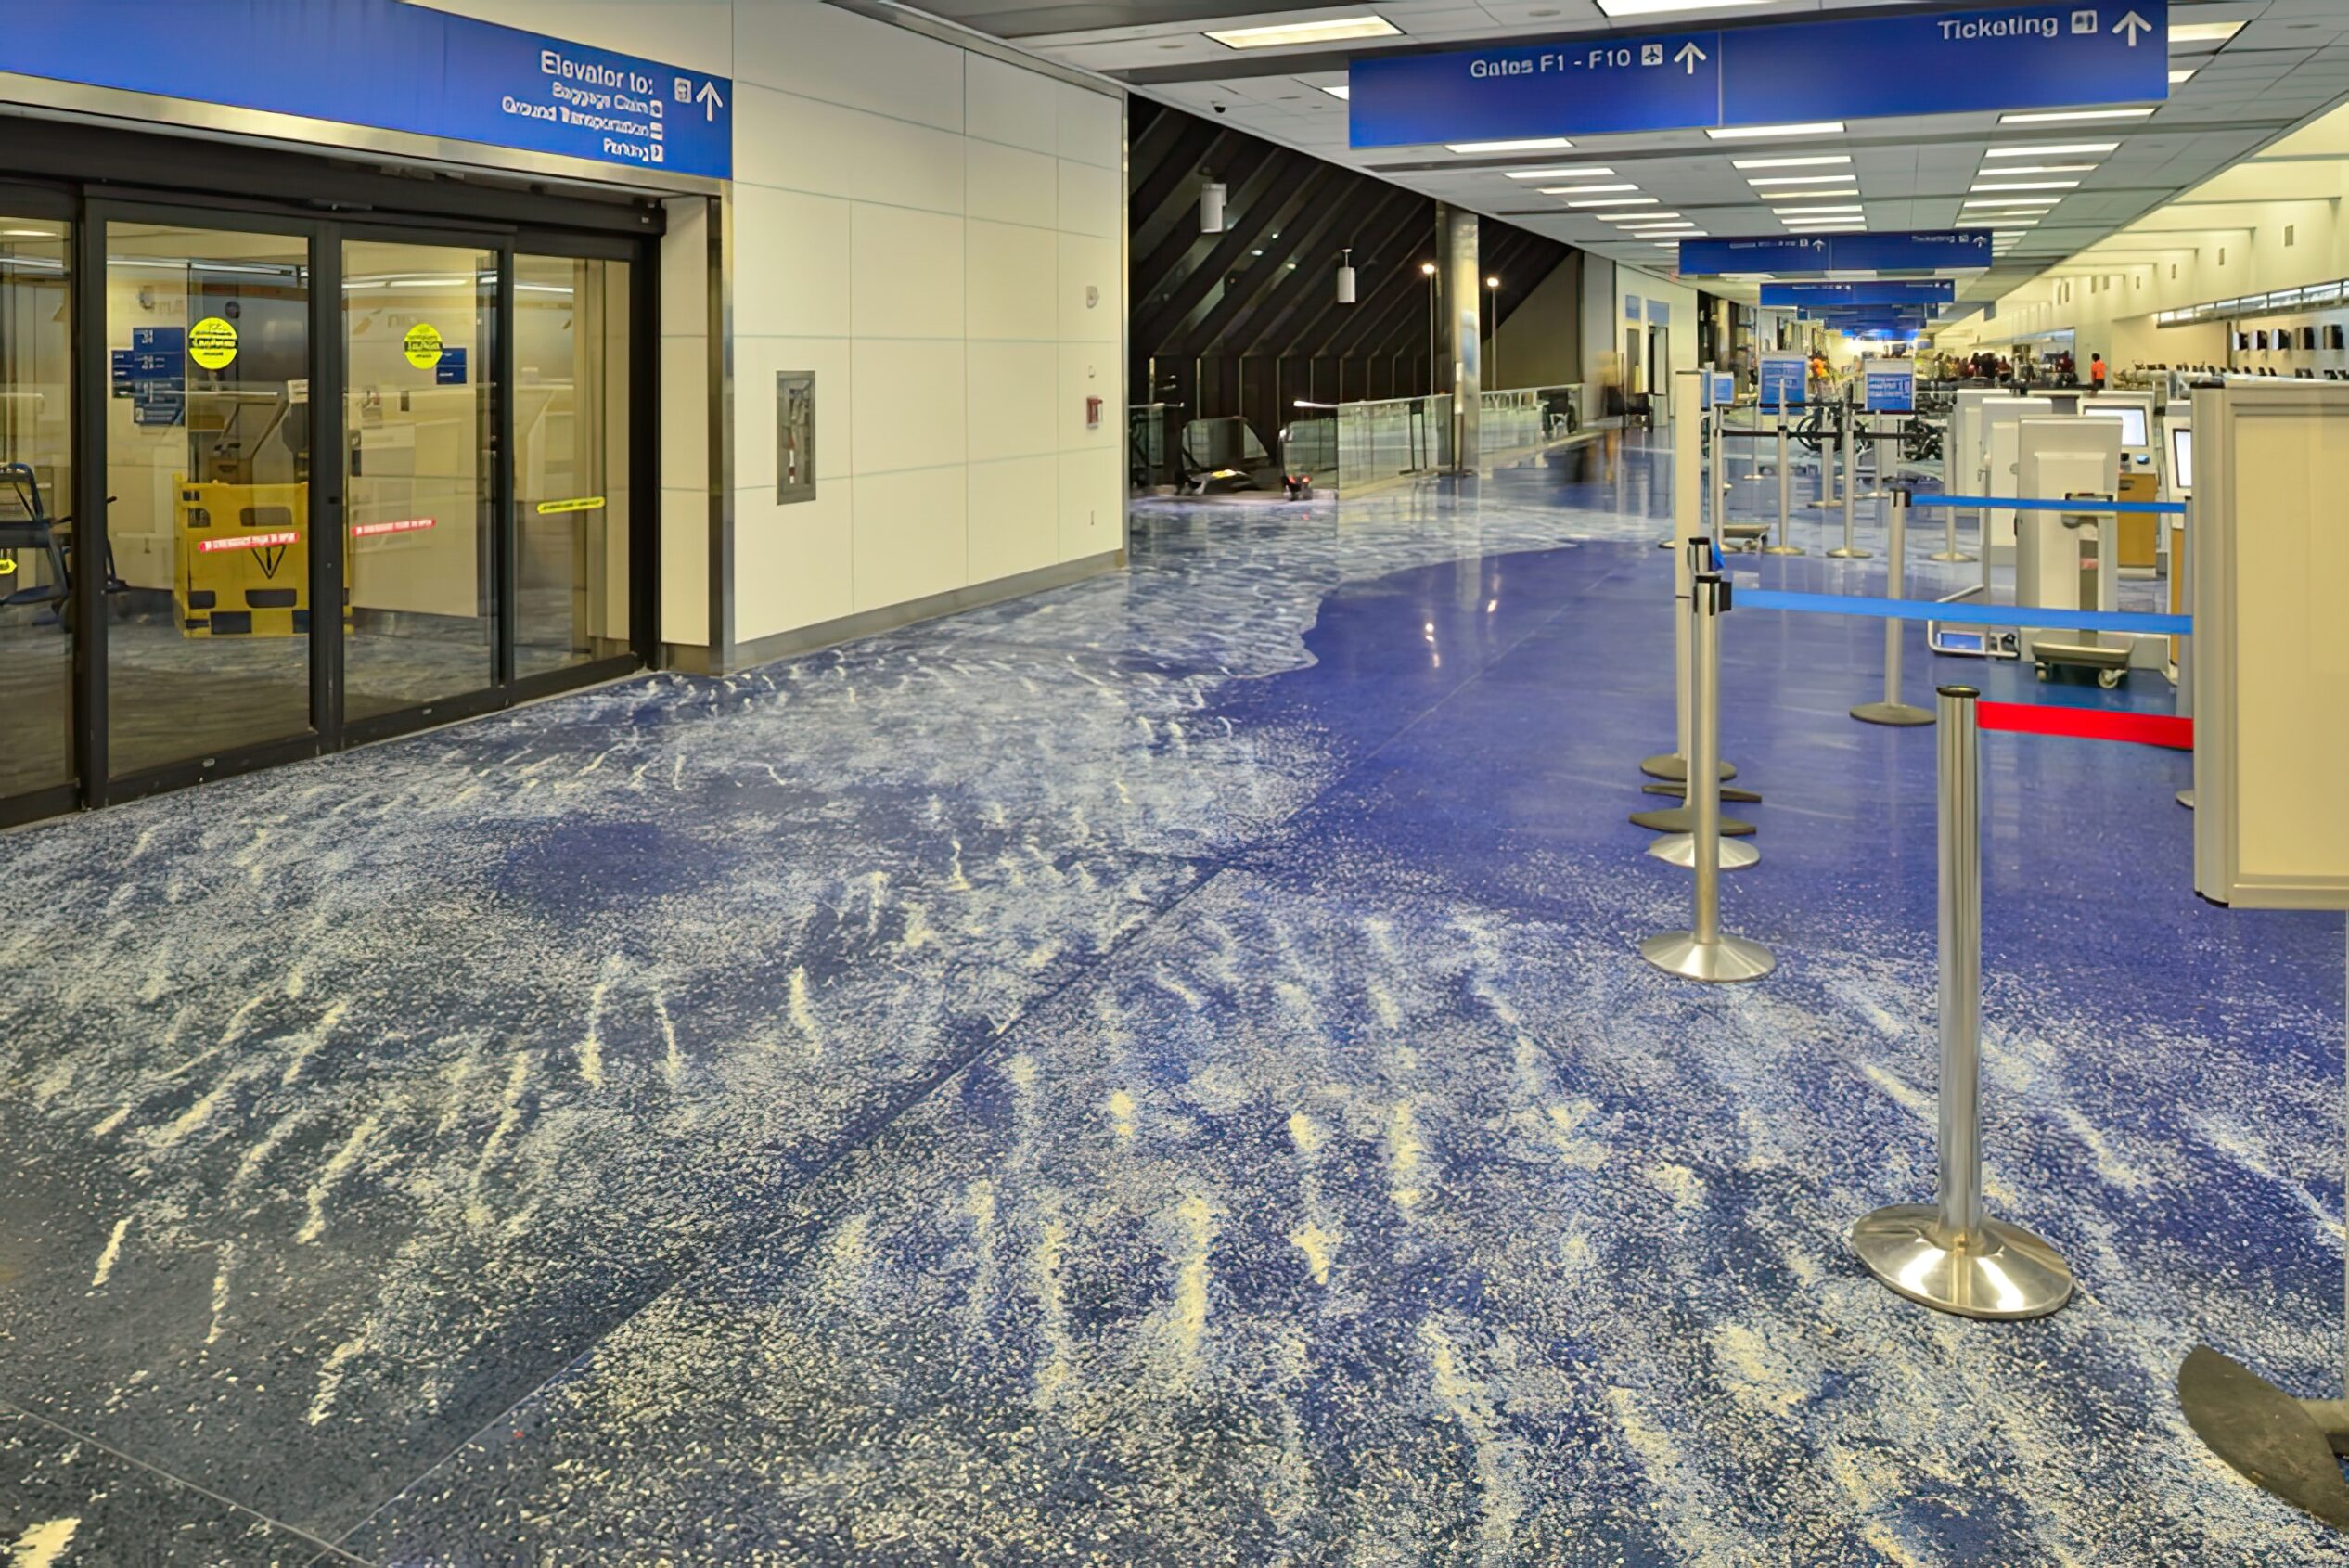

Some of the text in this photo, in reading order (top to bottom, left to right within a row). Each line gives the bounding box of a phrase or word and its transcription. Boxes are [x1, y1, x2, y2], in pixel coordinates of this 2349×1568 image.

[1937, 16, 2058, 39] Ticketing
[541, 50, 653, 95] Elevator to:
[1470, 59, 1533, 78] Gates
[1540, 54, 1564, 72] F1
[1589, 49, 1631, 70] F10
[552, 81, 648, 113] Baggage Claim
[502, 96, 649, 136] Ground Transportation
[604, 138, 648, 162] Parking
